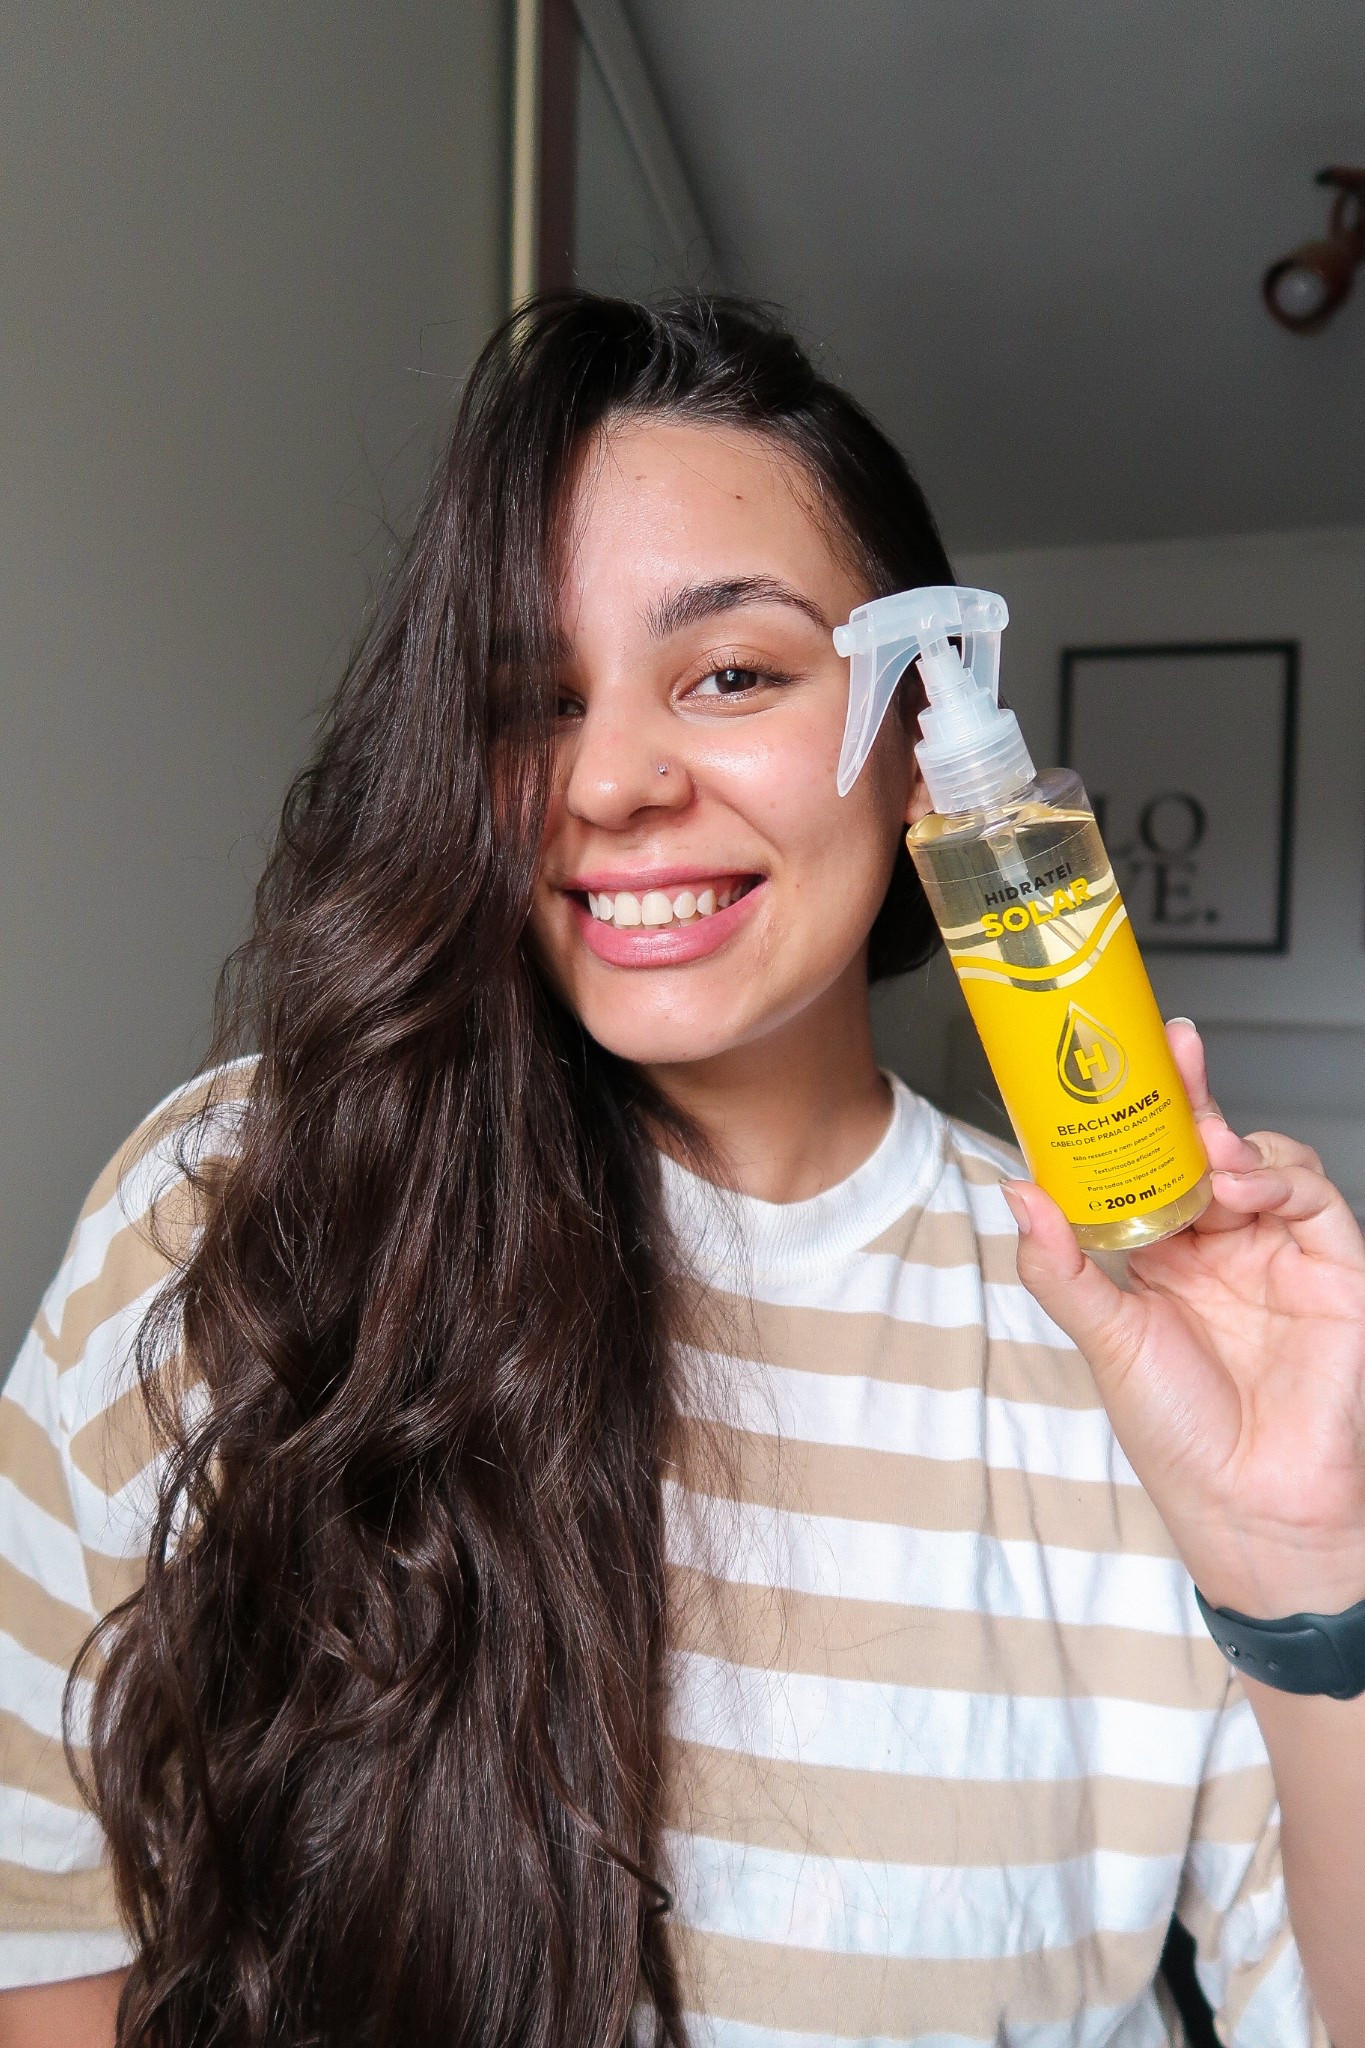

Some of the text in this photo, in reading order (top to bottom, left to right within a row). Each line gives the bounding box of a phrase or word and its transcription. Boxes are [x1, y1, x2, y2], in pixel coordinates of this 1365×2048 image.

[985, 862, 1072, 906] HIDRATEI
[980, 877, 1092, 938] SOLAR
[1050, 1139, 1083, 1148] CABELO
[1084, 1136, 1096, 1145] DE
[1097, 1128, 1123, 1141] PRAIA
[1132, 1115, 1149, 1129] ANO
[1148, 1098, 1172, 1119] INTEIRO
[1057, 1090, 1160, 1136] BEACH WAVES
[1104, 1193, 1137, 1210] 200
[1138, 1184, 1157, 1201] ml
[1157, 1181, 1172, 1193] 6,76
[1132, 1171, 1149, 1181] tipos
